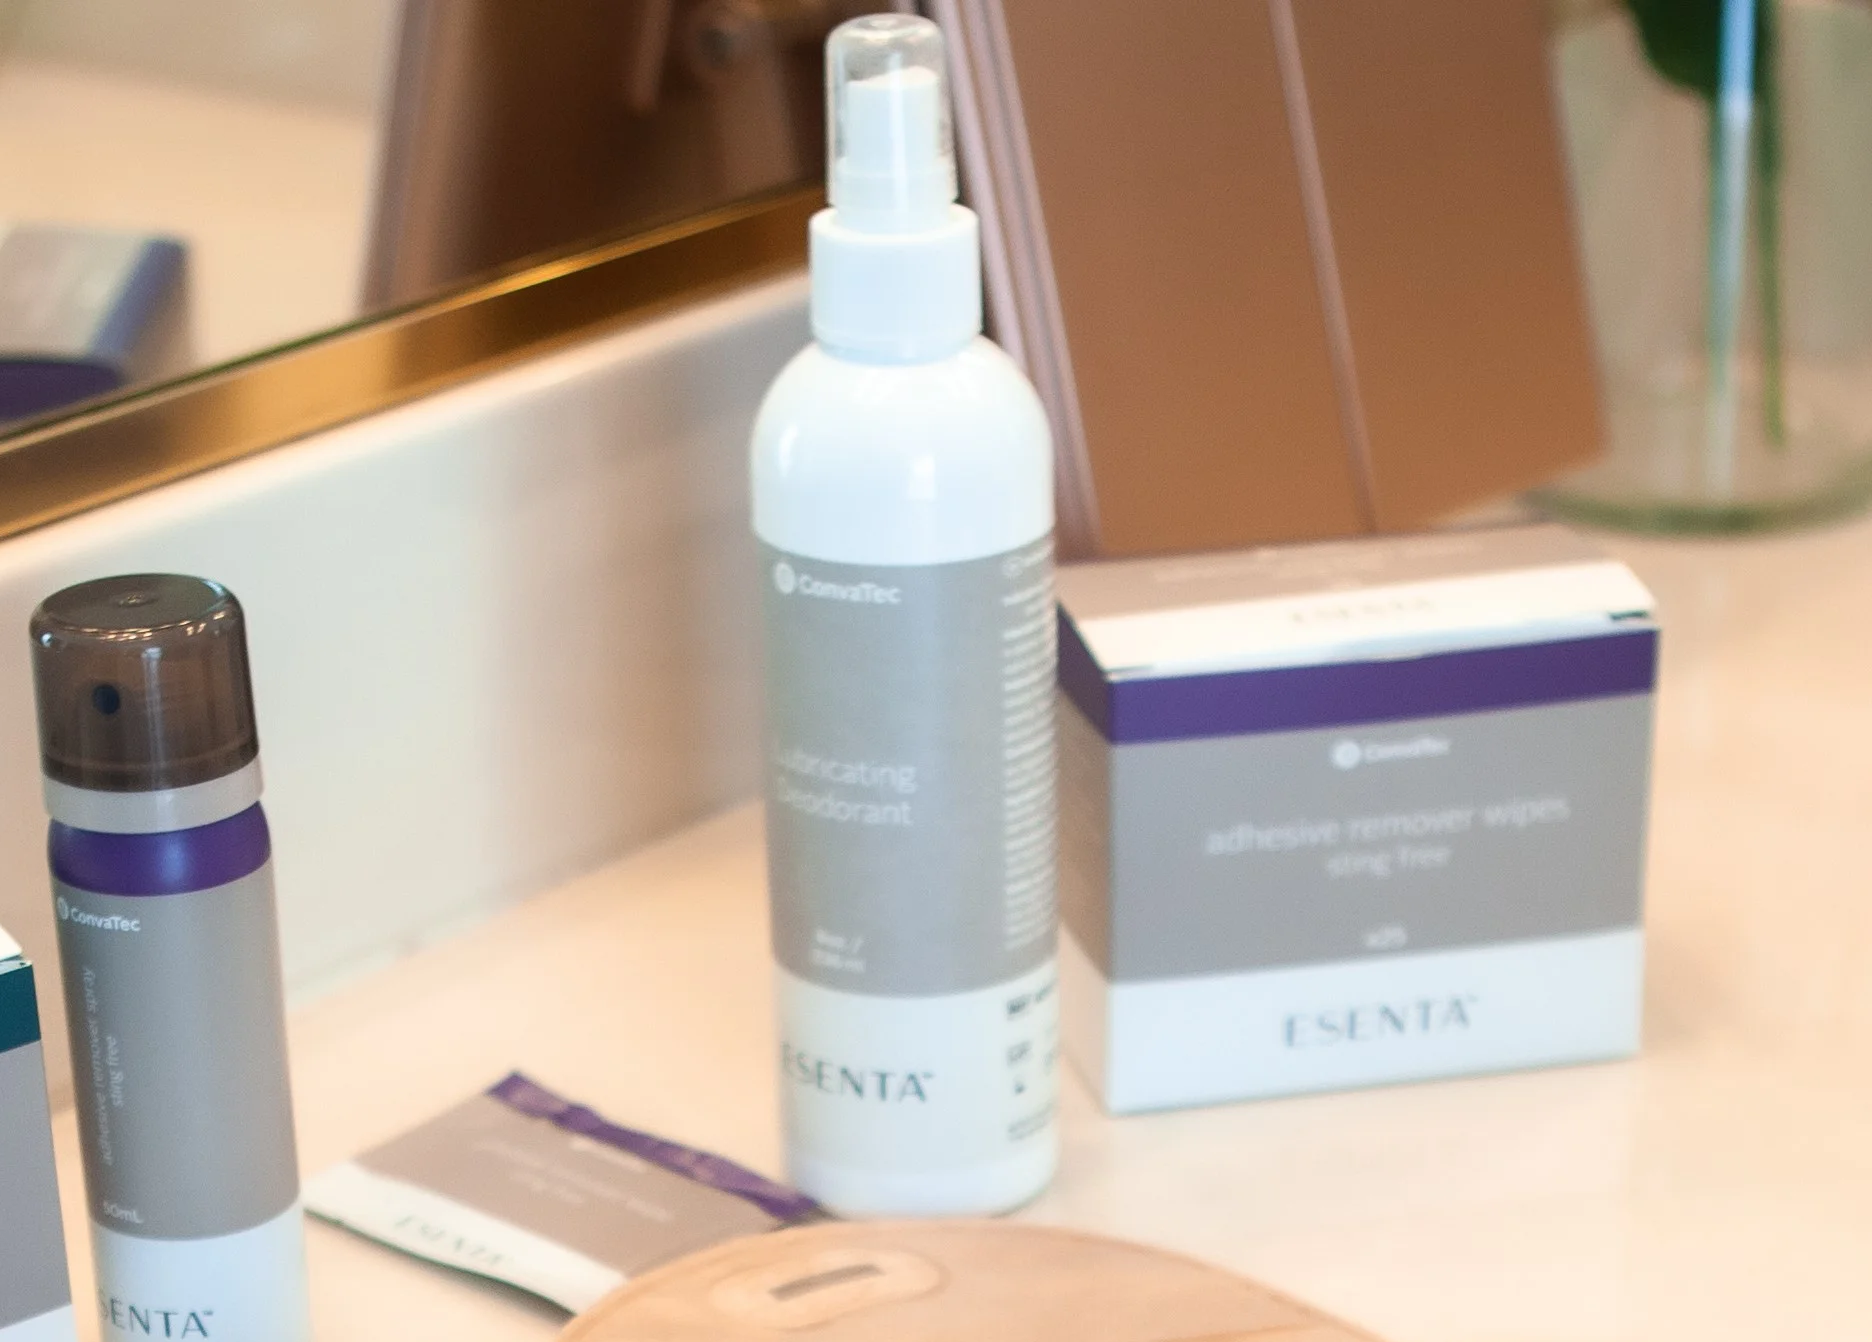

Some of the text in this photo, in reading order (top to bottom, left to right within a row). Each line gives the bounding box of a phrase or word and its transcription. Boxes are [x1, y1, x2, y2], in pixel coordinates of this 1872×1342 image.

[799, 573, 902, 604] ConvaTec
[1206, 796, 1571, 856] adhesive remover wipes
[1329, 844, 1452, 879] sting free
[70, 907, 141, 932] ConvaTec
[83, 967, 97, 1013] spray
[105, 1036, 124, 1107] sting free
